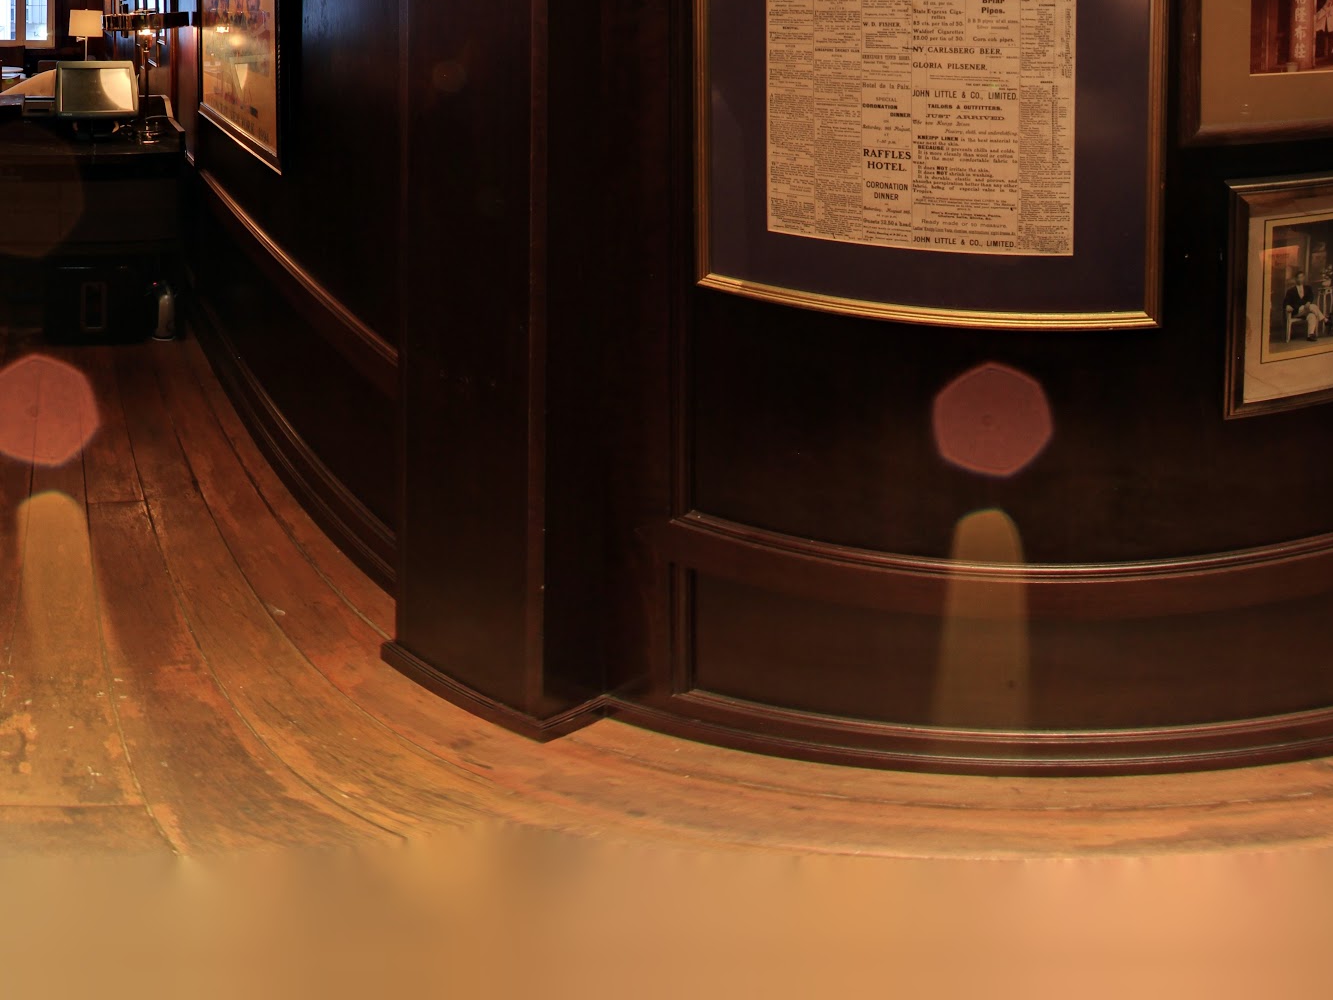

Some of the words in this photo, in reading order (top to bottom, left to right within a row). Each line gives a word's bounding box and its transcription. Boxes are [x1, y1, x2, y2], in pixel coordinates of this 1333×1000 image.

[912, 90, 930, 98] JOHN
[934, 90, 958, 98] LITTLE
[961, 91, 966, 99] &
[988, 92, 1018, 100] LIMITED.
[863, 148, 912, 160] RAFFLES
[867, 160, 908, 172] HOTEL.
[866, 180, 909, 191] CORONATION
[874, 192, 900, 200] DINNER
